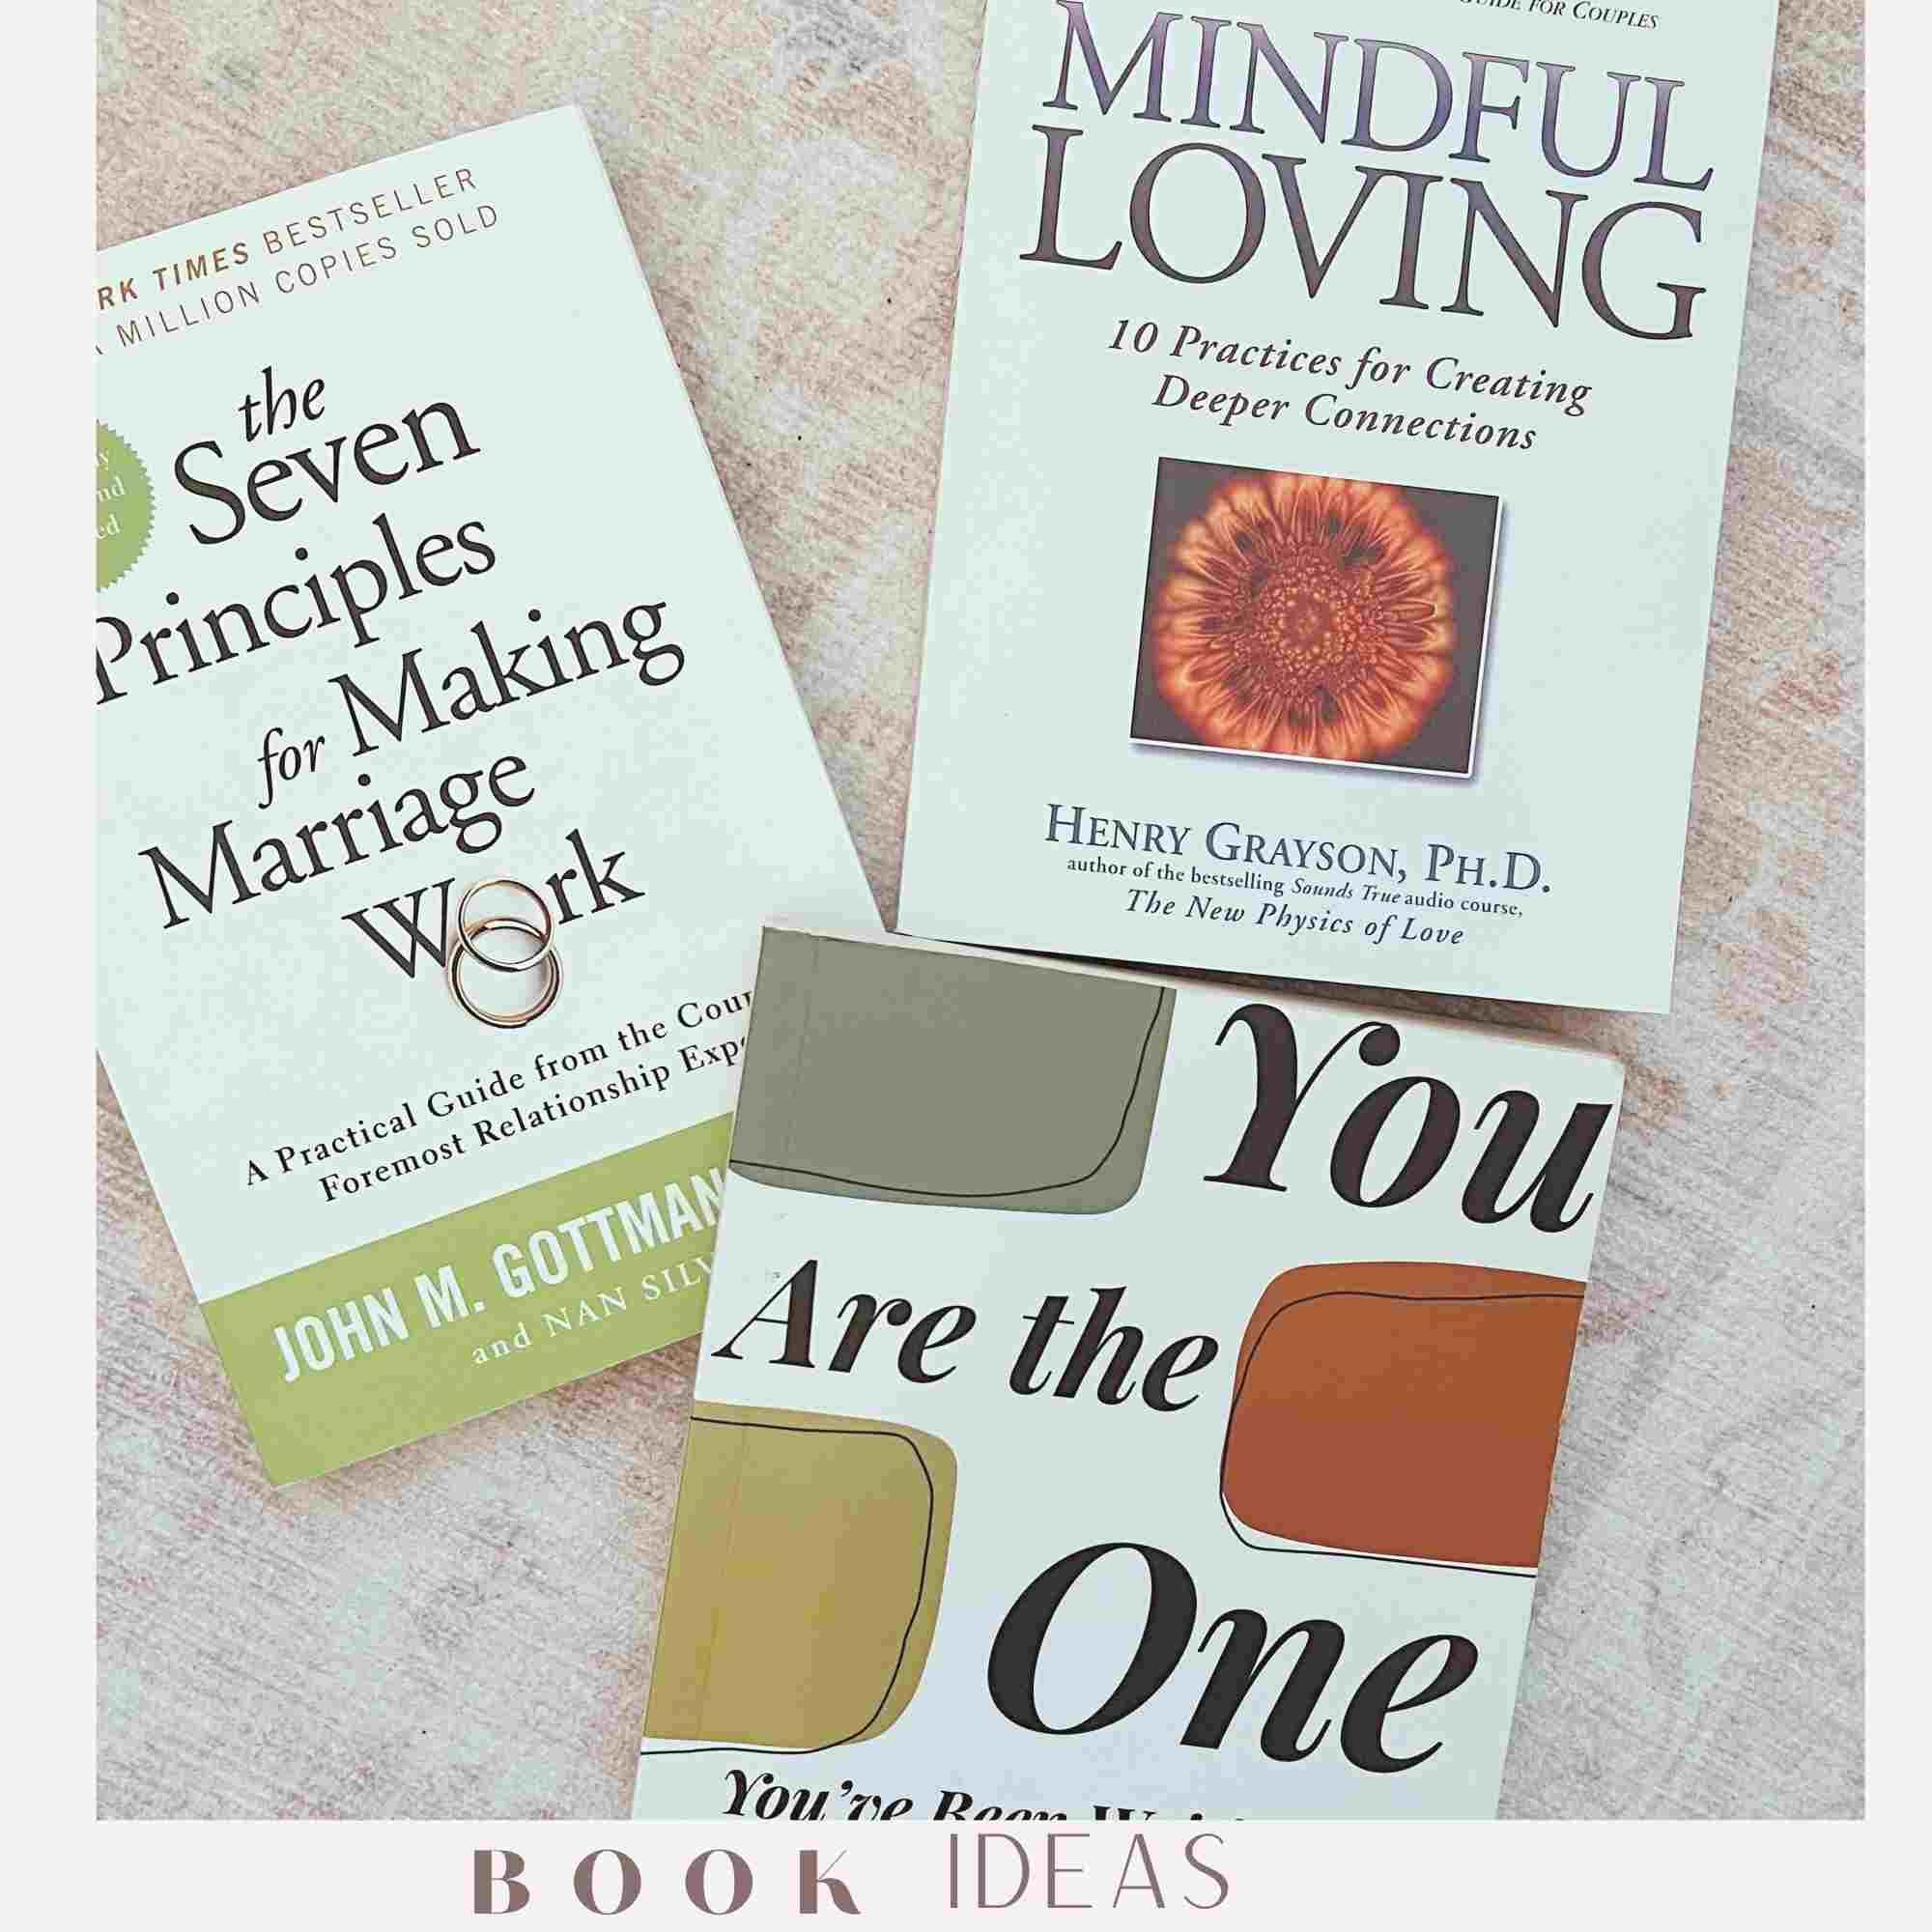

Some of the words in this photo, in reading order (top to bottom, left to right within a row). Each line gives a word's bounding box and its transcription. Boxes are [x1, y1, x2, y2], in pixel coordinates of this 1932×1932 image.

[1573, 1, 1660, 29] COUPLES
[1041, 1, 1715, 191] MINDFUL
[116, 281, 260, 348] MILLION
[275, 236, 399, 294] COPIES
[412, 205, 498, 248] SOLD
[153, 242, 249, 291] TIMES
[263, 168, 478, 254] BESTSELLER
[1020, 125, 1706, 340] LOVING
[238, 366, 326, 441] the
[1108, 319, 1159, 354] 10
[1170, 325, 1342, 376] Practices
[1345, 346, 1410, 389] for
[1427, 356, 1592, 416] Creating
[1152, 374, 1290, 427] Deeper
[1304, 393, 1537, 450] Connections
[174, 401, 481, 545] Seven
[96, 513, 496, 704] Principles
[257, 727, 326, 810] for
[328, 601, 685, 756] Making
[138, 755, 535, 929] Marriage
[1066, 857, 1127, 877] author
[1132, 862, 1155, 879] of
[1156, 864, 1185, 883] the
[1190, 867, 1285, 897] bestselling
[1291, 878, 1353, 899] Sounds
[1361, 885, 1401, 905] True
[1405, 891, 1455, 910] audio
[1461, 897, 1524, 918] course,
[1124, 889, 1176, 915] The
[1184, 895, 1244, 923] New
[1256, 902, 1353, 935] Physics
[1363, 913, 1392, 944] of
[1401, 917, 1464, 946] Love
[246, 1158, 270, 1186] A
[274, 1102, 418, 1172] Practical
[427, 1069, 526, 1118] Guide
[535, 1042, 609, 1082] from
[617, 1021, 668, 1052] the
[318, 1133, 468, 1202] Foremost
[473, 1064, 670, 1147] Relationship
[677, 1035, 745, 1073] Exp
[1203, 1004, 1613, 1234] You
[271, 1286, 409, 1382] JOHN
[415, 1264, 486, 1327] M.
[492, 1166, 726, 1298] GOTTMAN
[470, 1321, 532, 1364] and
[542, 1285, 628, 1337] NAN
[712, 1259, 977, 1383] Are
[1009, 1285, 1219, 1412] the
[987, 1543, 1479, 1774] One
